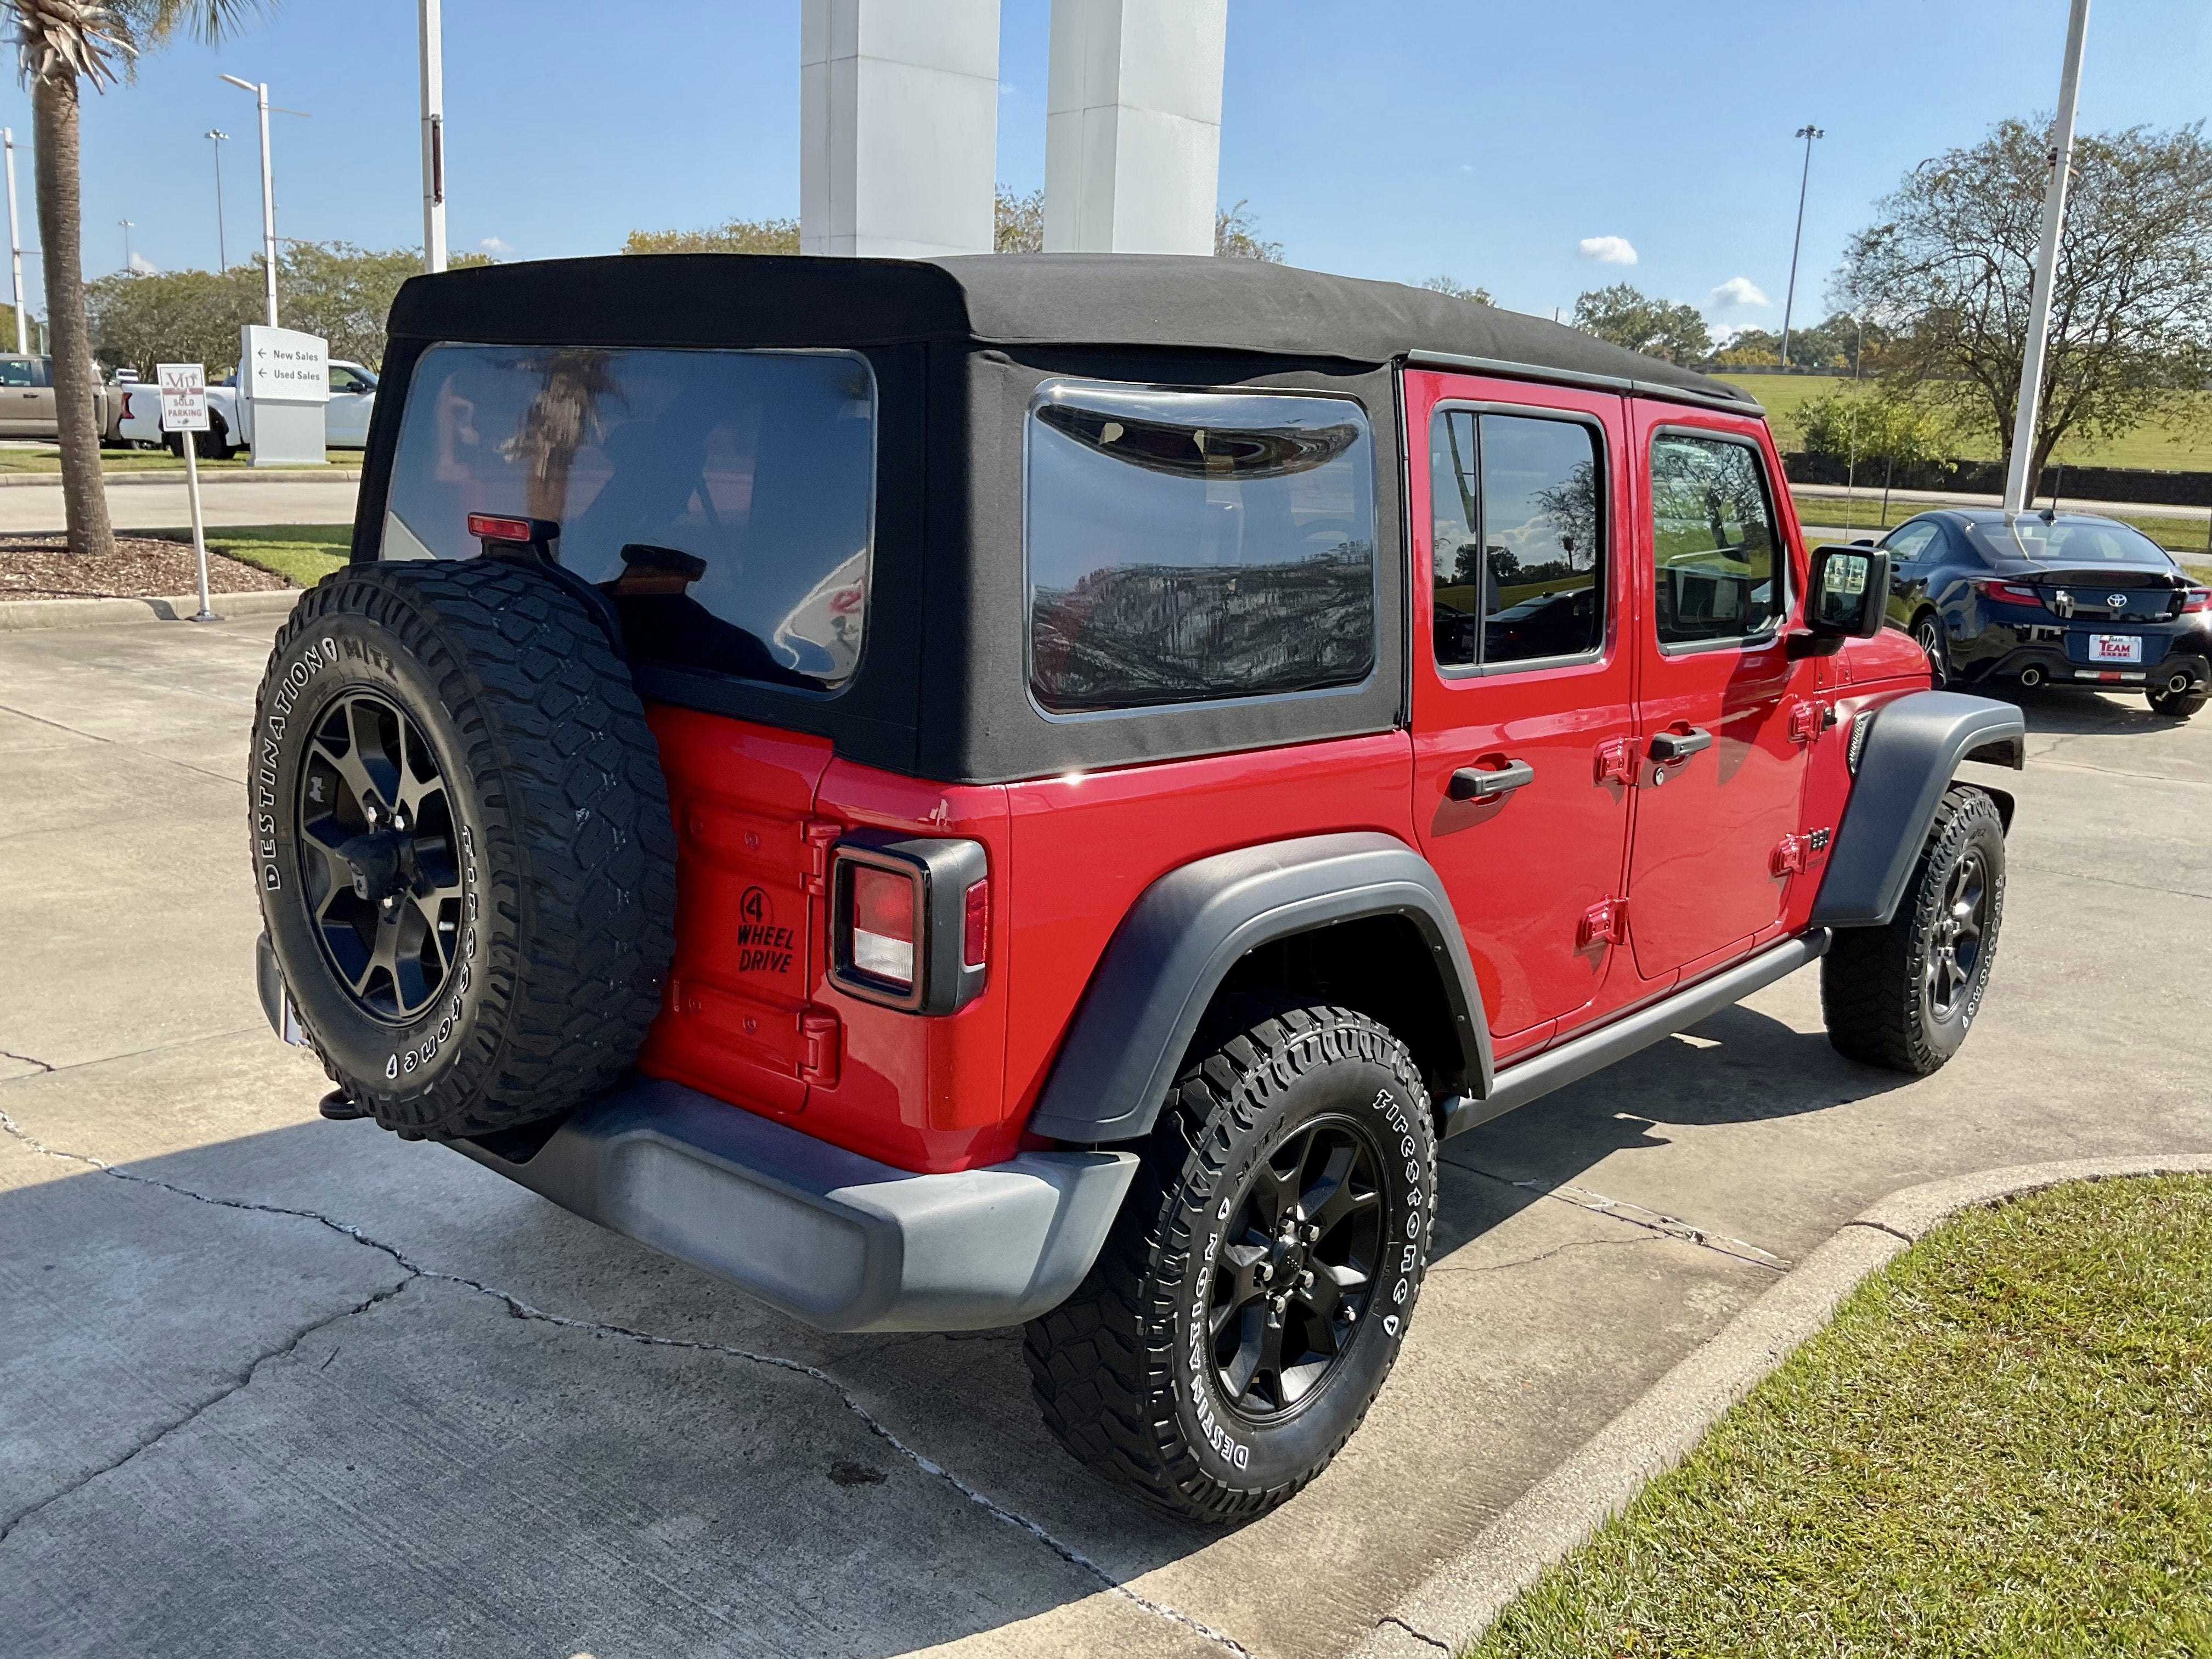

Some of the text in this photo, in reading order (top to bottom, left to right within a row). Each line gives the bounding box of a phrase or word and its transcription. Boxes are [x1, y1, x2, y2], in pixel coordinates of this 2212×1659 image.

[274, 350, 318, 361] New Sales
[274, 369, 320, 381] Used Sales
[173, 398, 194, 407] SOLD
[2099, 640, 2131, 652] TEAM
[258, 645, 324, 891] DESTINATION
[746, 892, 763, 922] 4
[737, 924, 794, 950] WHEEL
[738, 948, 794, 973] DRIVE
[1189, 1233, 1249, 1470] DESTINATION
